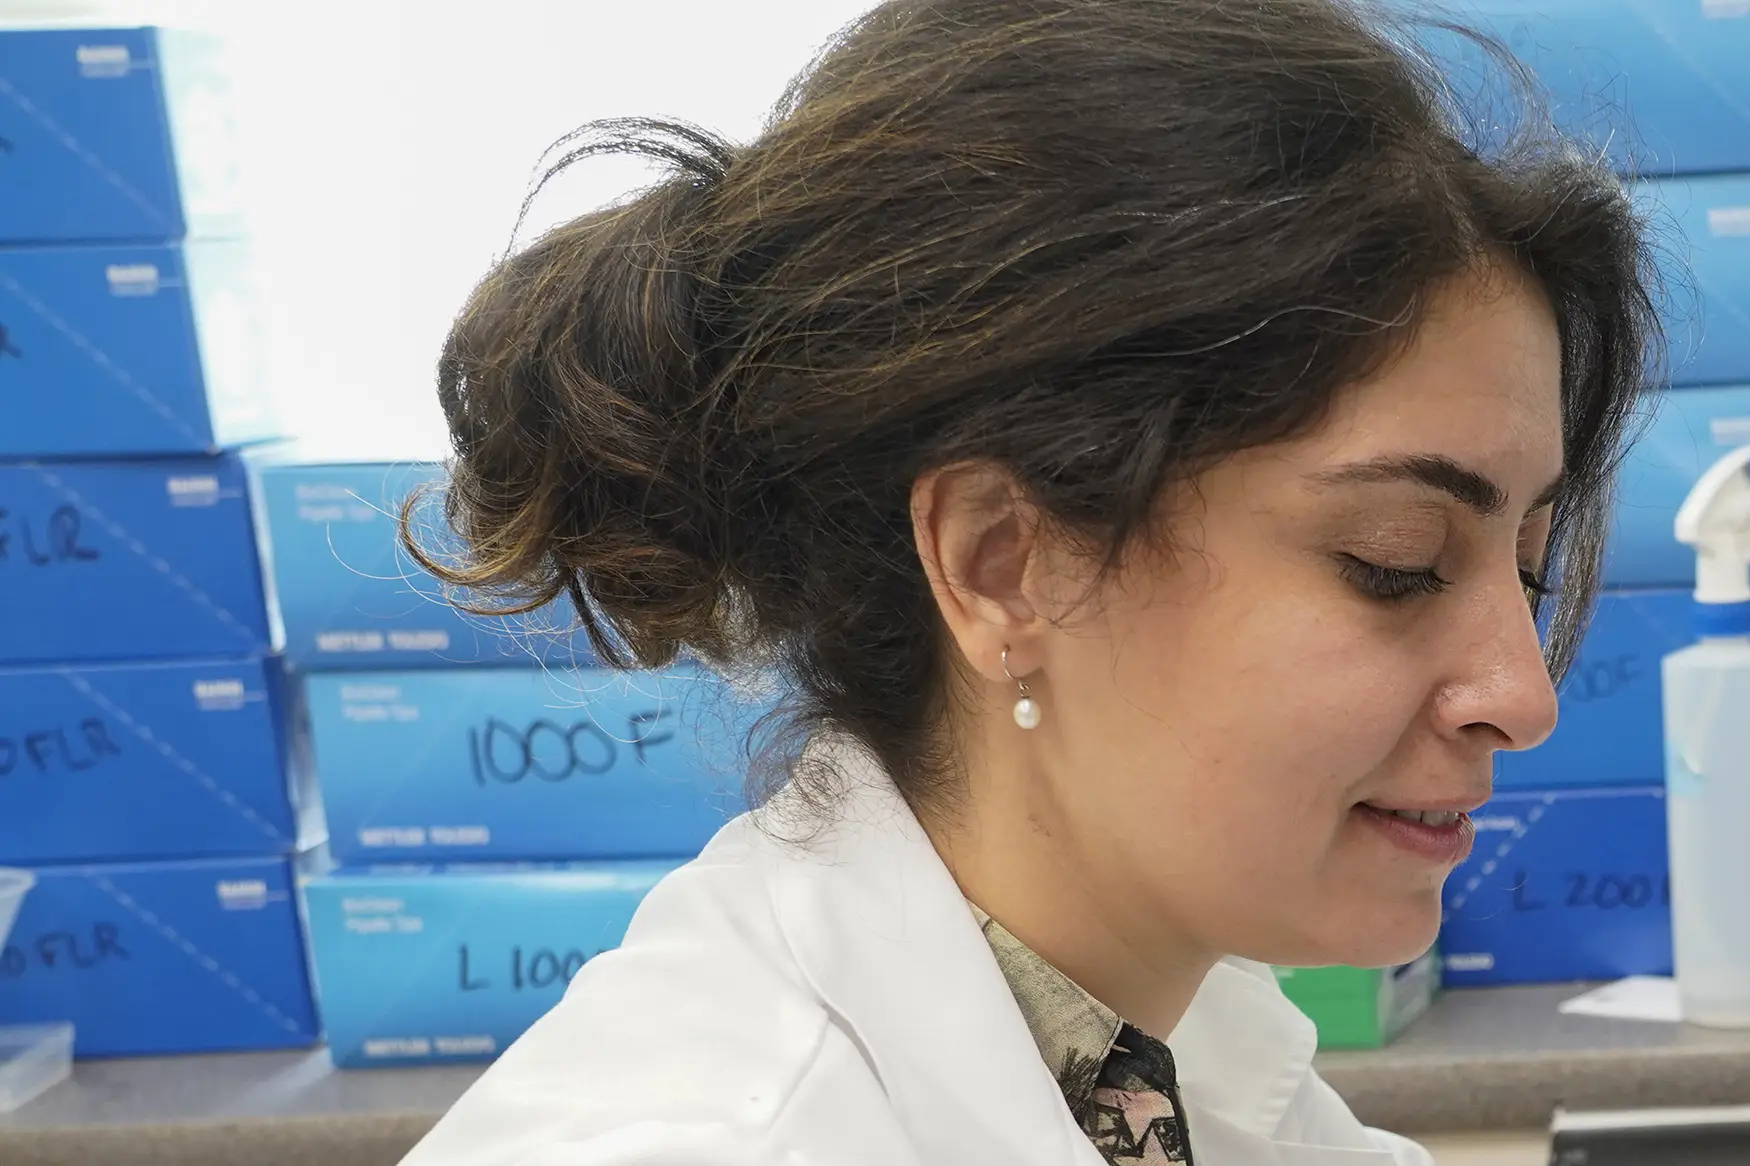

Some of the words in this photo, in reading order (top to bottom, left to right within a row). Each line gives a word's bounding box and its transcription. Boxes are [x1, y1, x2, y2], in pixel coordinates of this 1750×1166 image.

[468, 716, 619, 787] 1000
[628, 708, 676, 764] F
[458, 943, 491, 992] L
